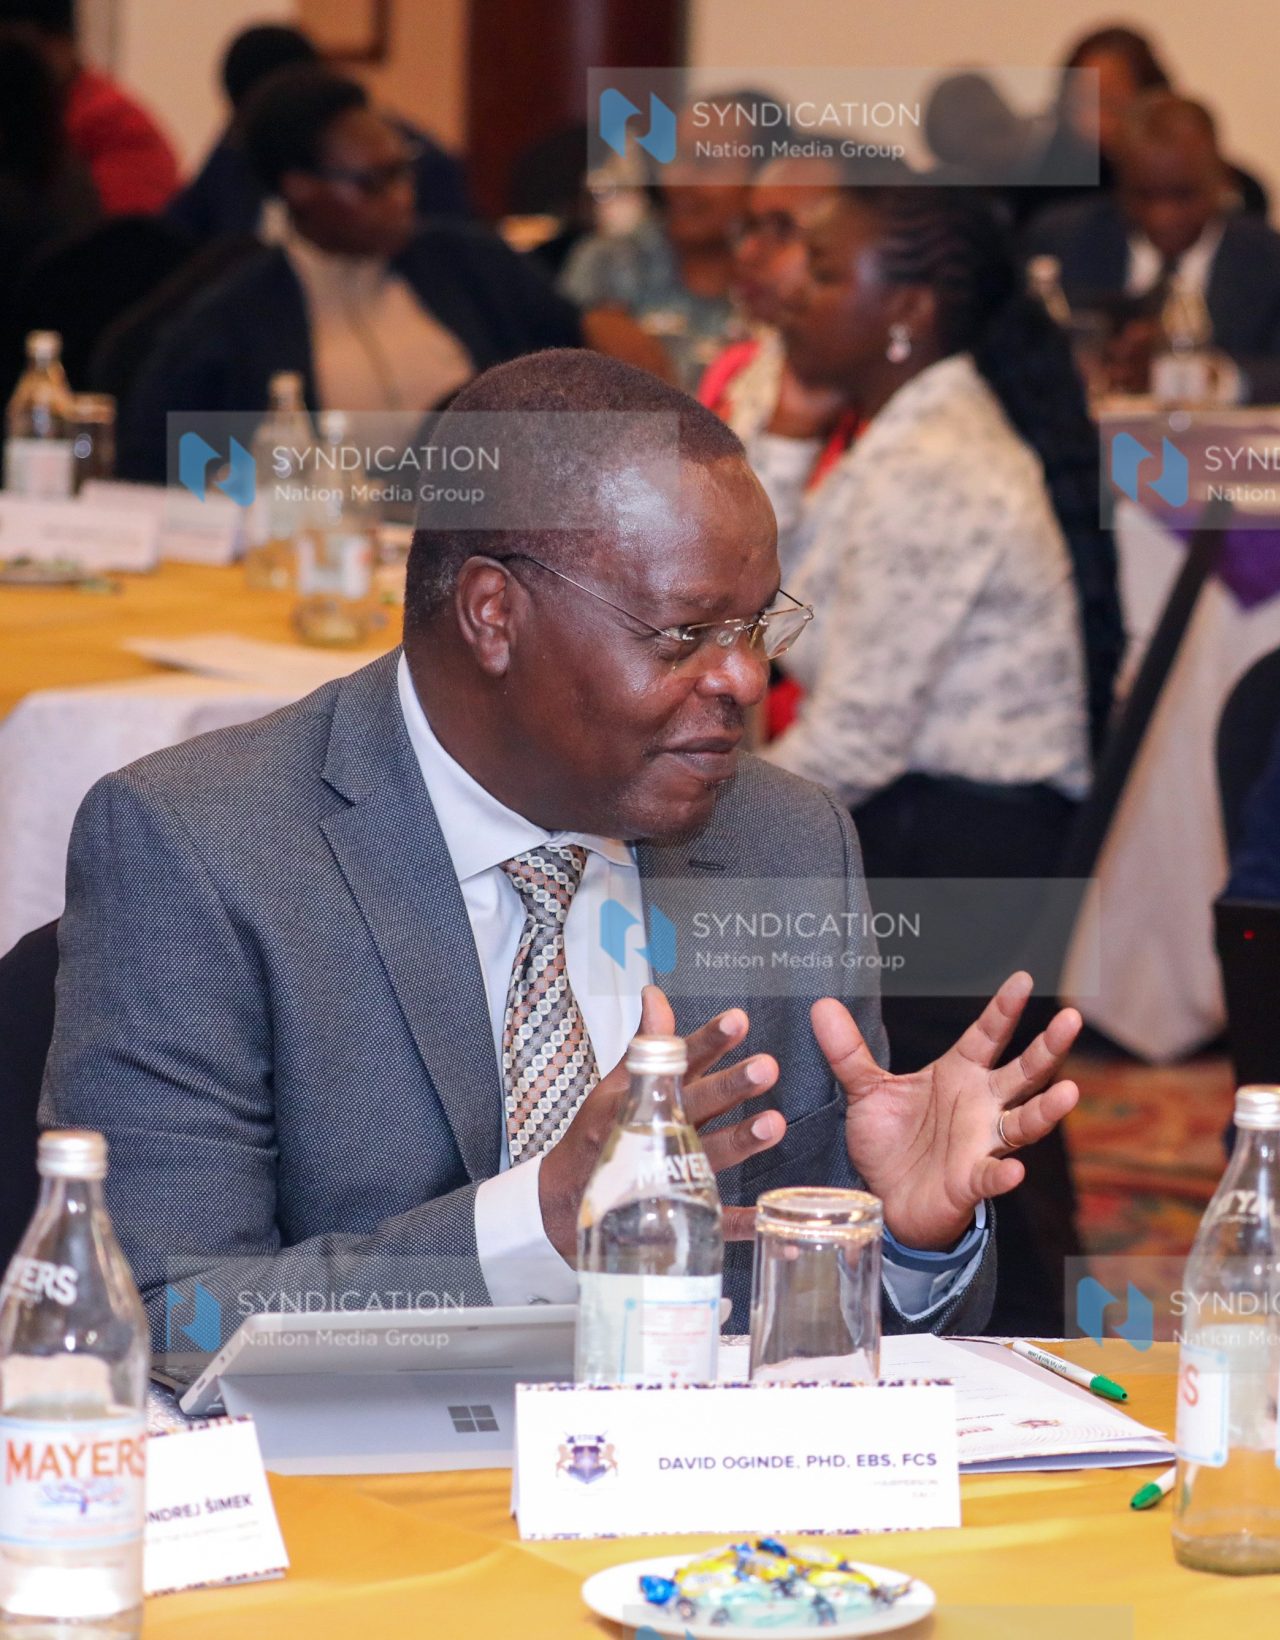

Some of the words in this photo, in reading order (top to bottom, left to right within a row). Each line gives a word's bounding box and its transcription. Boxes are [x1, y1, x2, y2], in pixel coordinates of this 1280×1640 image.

[658, 1456, 716, 1470] DAVID
[902, 1453, 937, 1467] FCS
[144, 1503, 201, 1523] NDREJ
